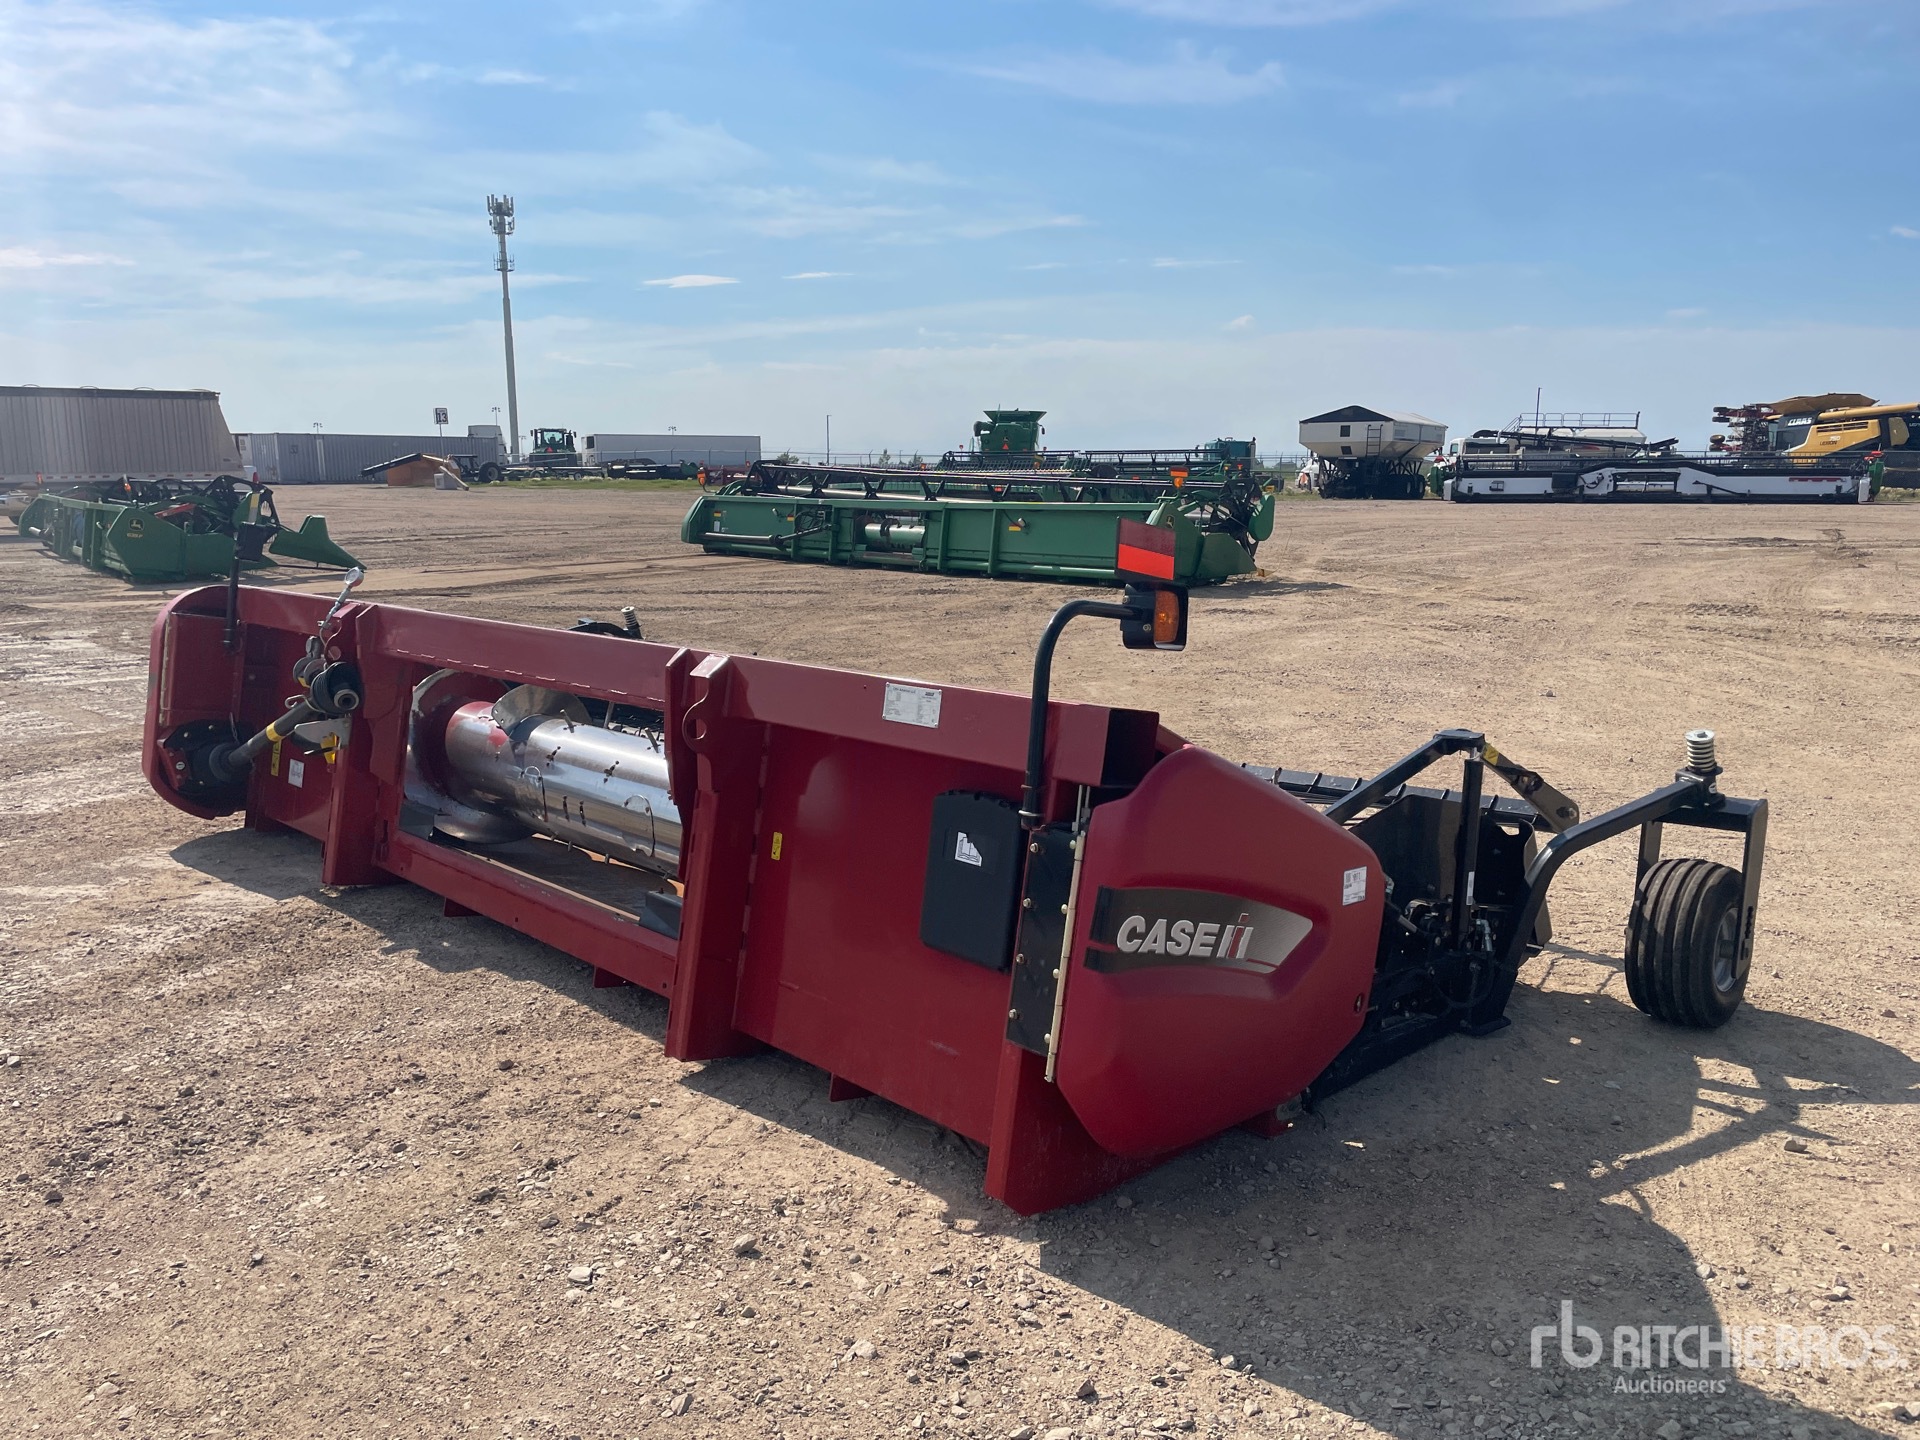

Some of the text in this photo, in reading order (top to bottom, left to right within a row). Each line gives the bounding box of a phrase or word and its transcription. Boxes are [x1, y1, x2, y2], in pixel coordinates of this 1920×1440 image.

[437, 412, 447, 423] 13
[1788, 417, 1813, 426] CLAAS
[1116, 915, 1221, 957] CASE
